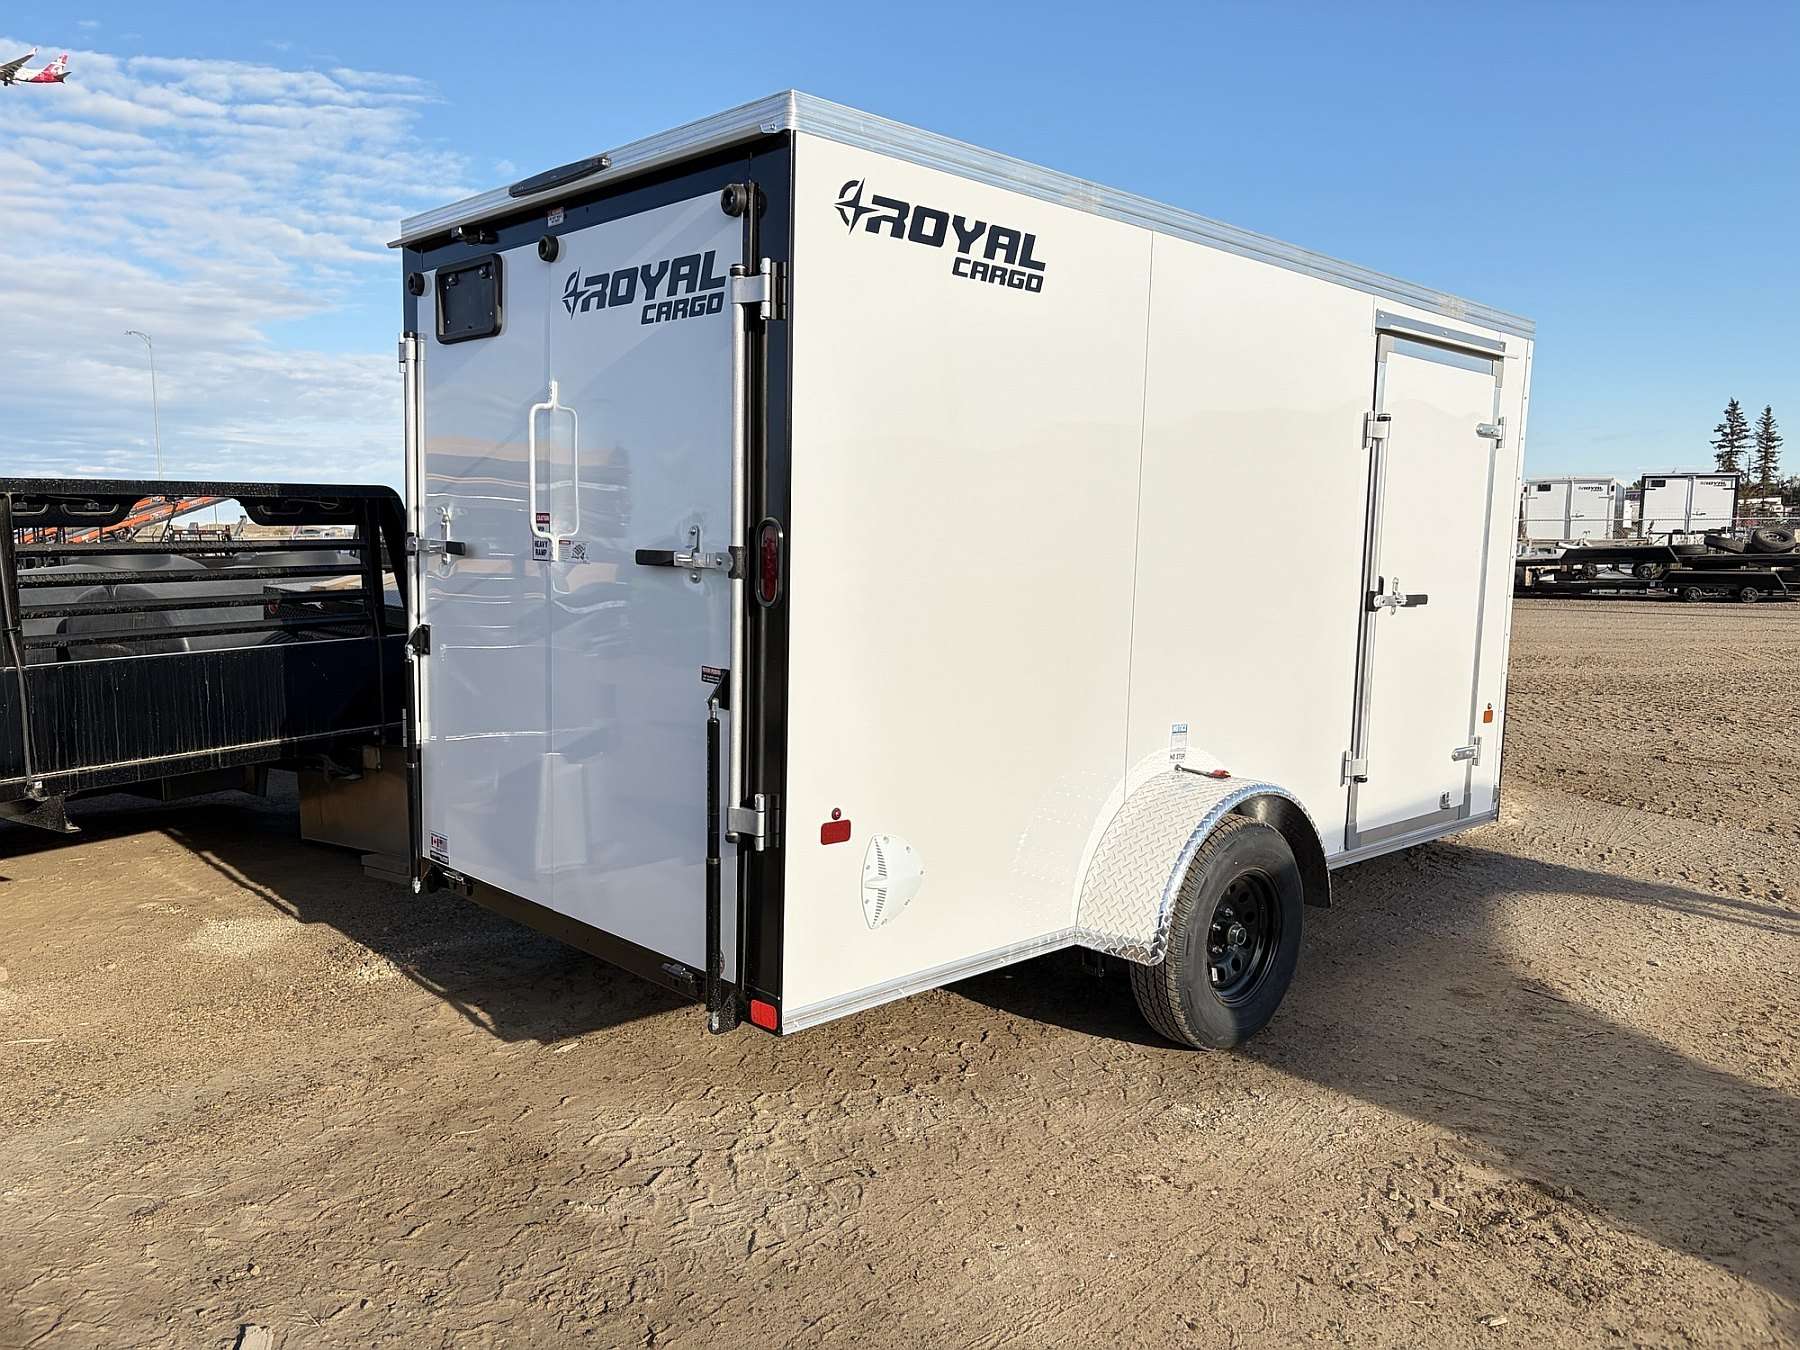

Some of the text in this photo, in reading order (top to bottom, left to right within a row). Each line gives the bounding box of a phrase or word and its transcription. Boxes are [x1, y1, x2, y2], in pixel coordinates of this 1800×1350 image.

[865, 194, 1046, 272] ROYAL
[580, 250, 727, 312] ROYAL
[952, 257, 1044, 293] CARGO
[641, 291, 725, 325] CARGO
[534, 540, 548, 548] HEAVY
[535, 548, 548, 556] RAMP
